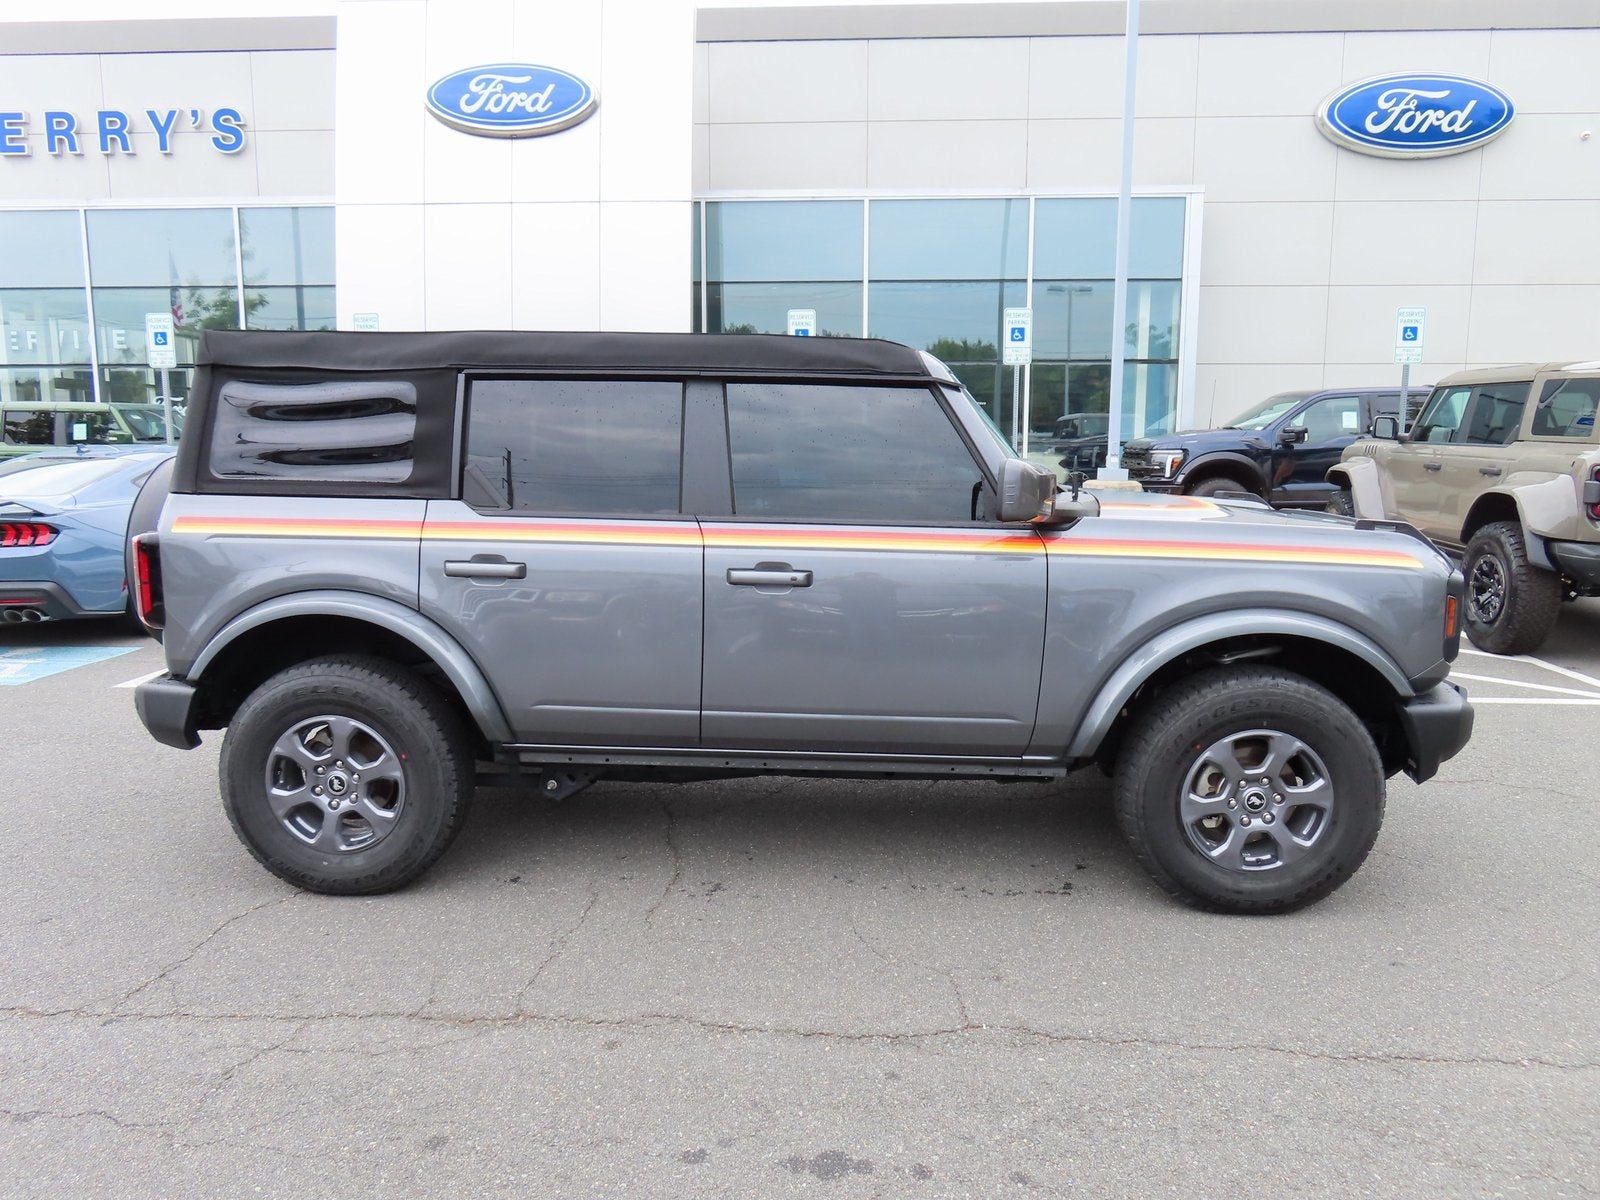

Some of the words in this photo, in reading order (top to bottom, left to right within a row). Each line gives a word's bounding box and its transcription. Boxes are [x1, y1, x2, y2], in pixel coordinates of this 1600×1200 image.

[459, 74, 556, 114] Ford
[1364, 88, 1478, 134] Ford
[0, 107, 246, 155] ERRY'S
